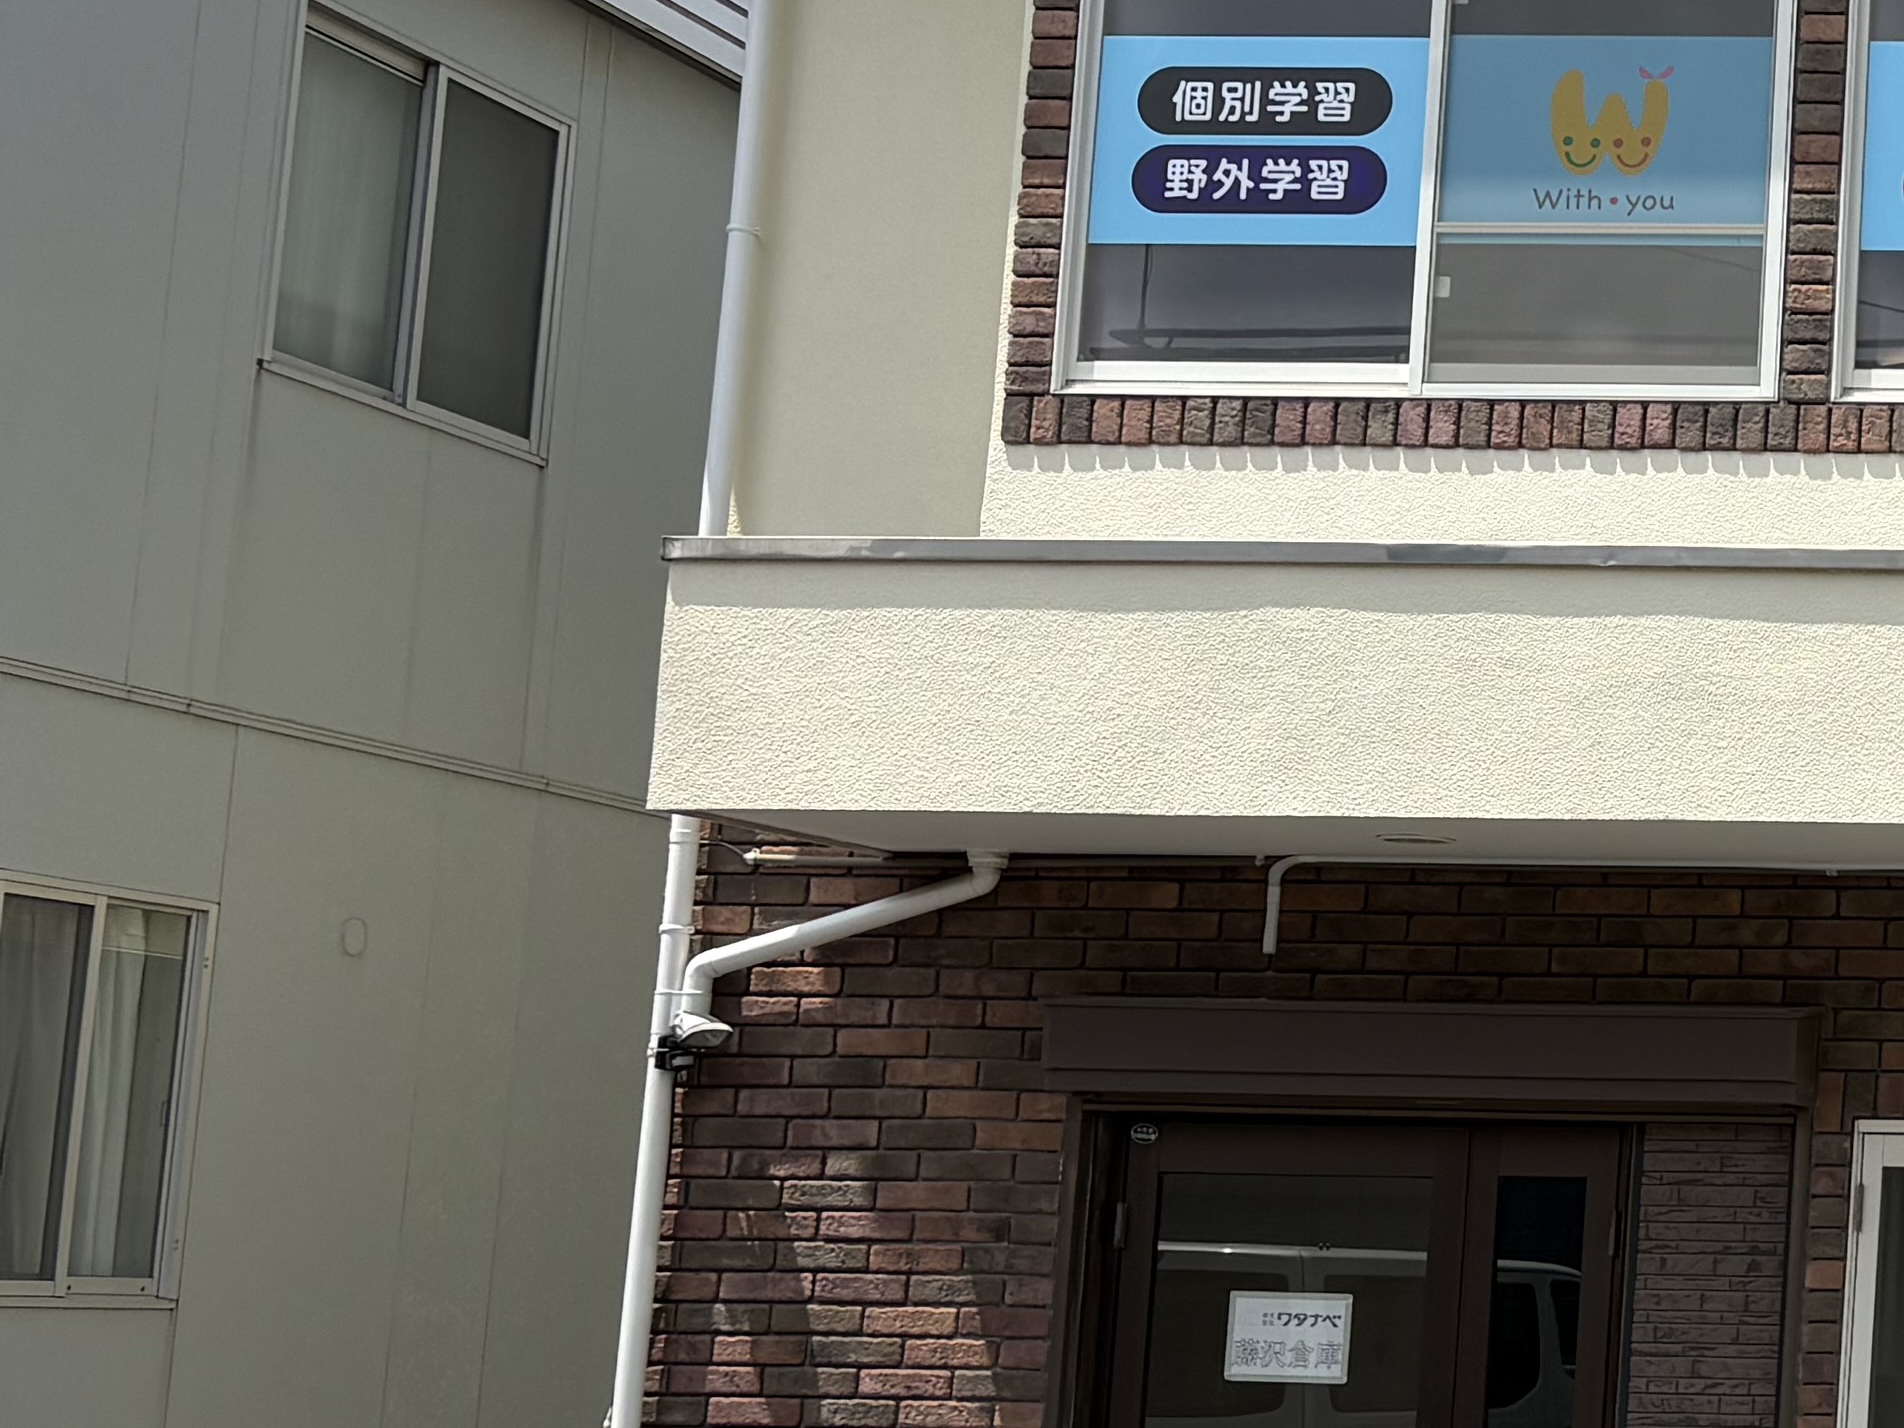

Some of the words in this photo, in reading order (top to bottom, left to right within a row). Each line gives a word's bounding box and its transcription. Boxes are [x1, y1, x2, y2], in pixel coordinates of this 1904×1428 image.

[1172, 79, 1357, 123] 個別学習
[1164, 158, 1350, 202] 野外学習
[1277, 1312, 1342, 1328] ワタナベ
[1231, 1339, 1343, 1370] 藤沢倉庫
